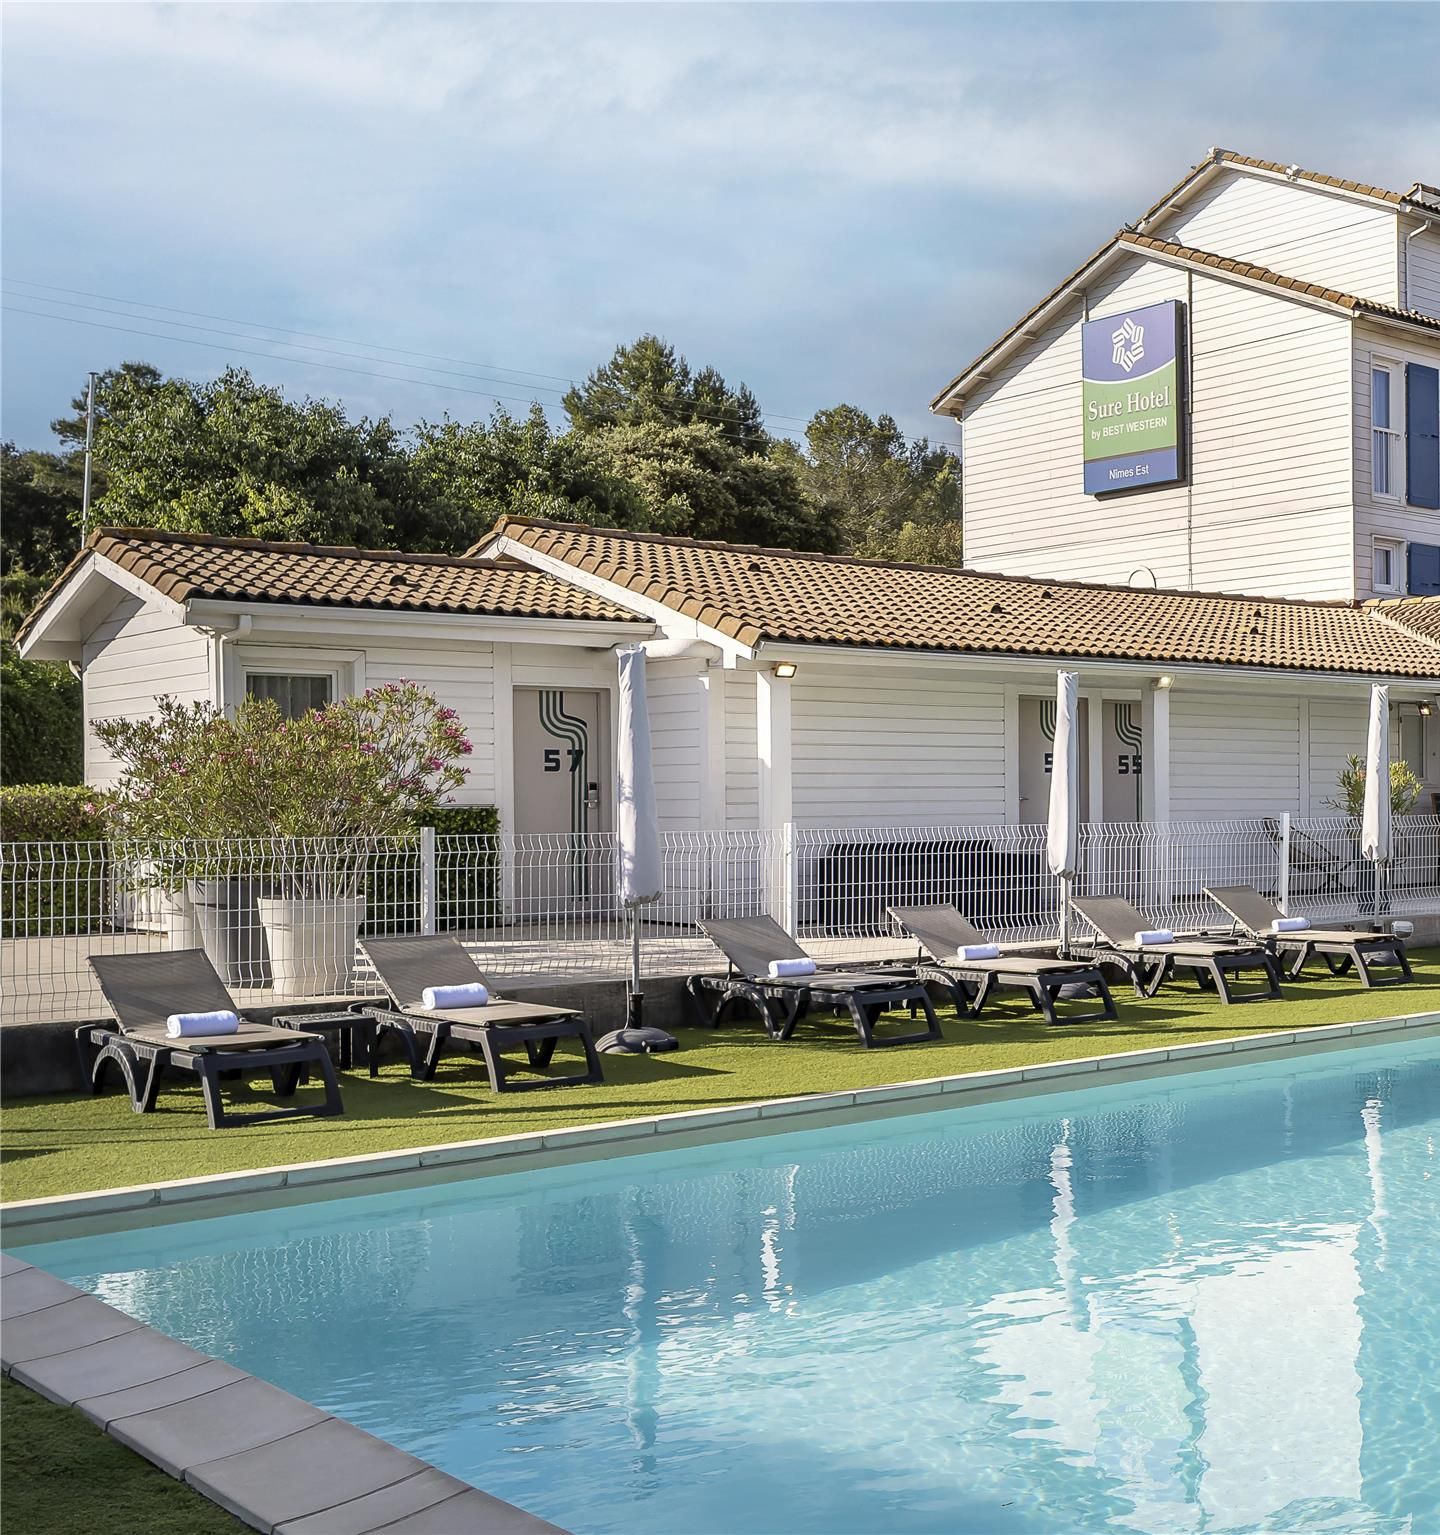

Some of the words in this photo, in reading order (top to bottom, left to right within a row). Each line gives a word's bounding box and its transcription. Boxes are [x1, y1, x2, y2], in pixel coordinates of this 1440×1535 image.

[1088, 400, 1123, 421] Sure
[1126, 385, 1171, 414] Hotel
[1091, 429, 1101, 441] by
[1102, 424, 1125, 437] BEST
[1125, 415, 1168, 433] WESTERN
[1135, 464, 1149, 476] Est
[544, 749, 584, 772] 57
[1044, 753, 1053, 773] 5
[1118, 754, 1142, 775] 55
